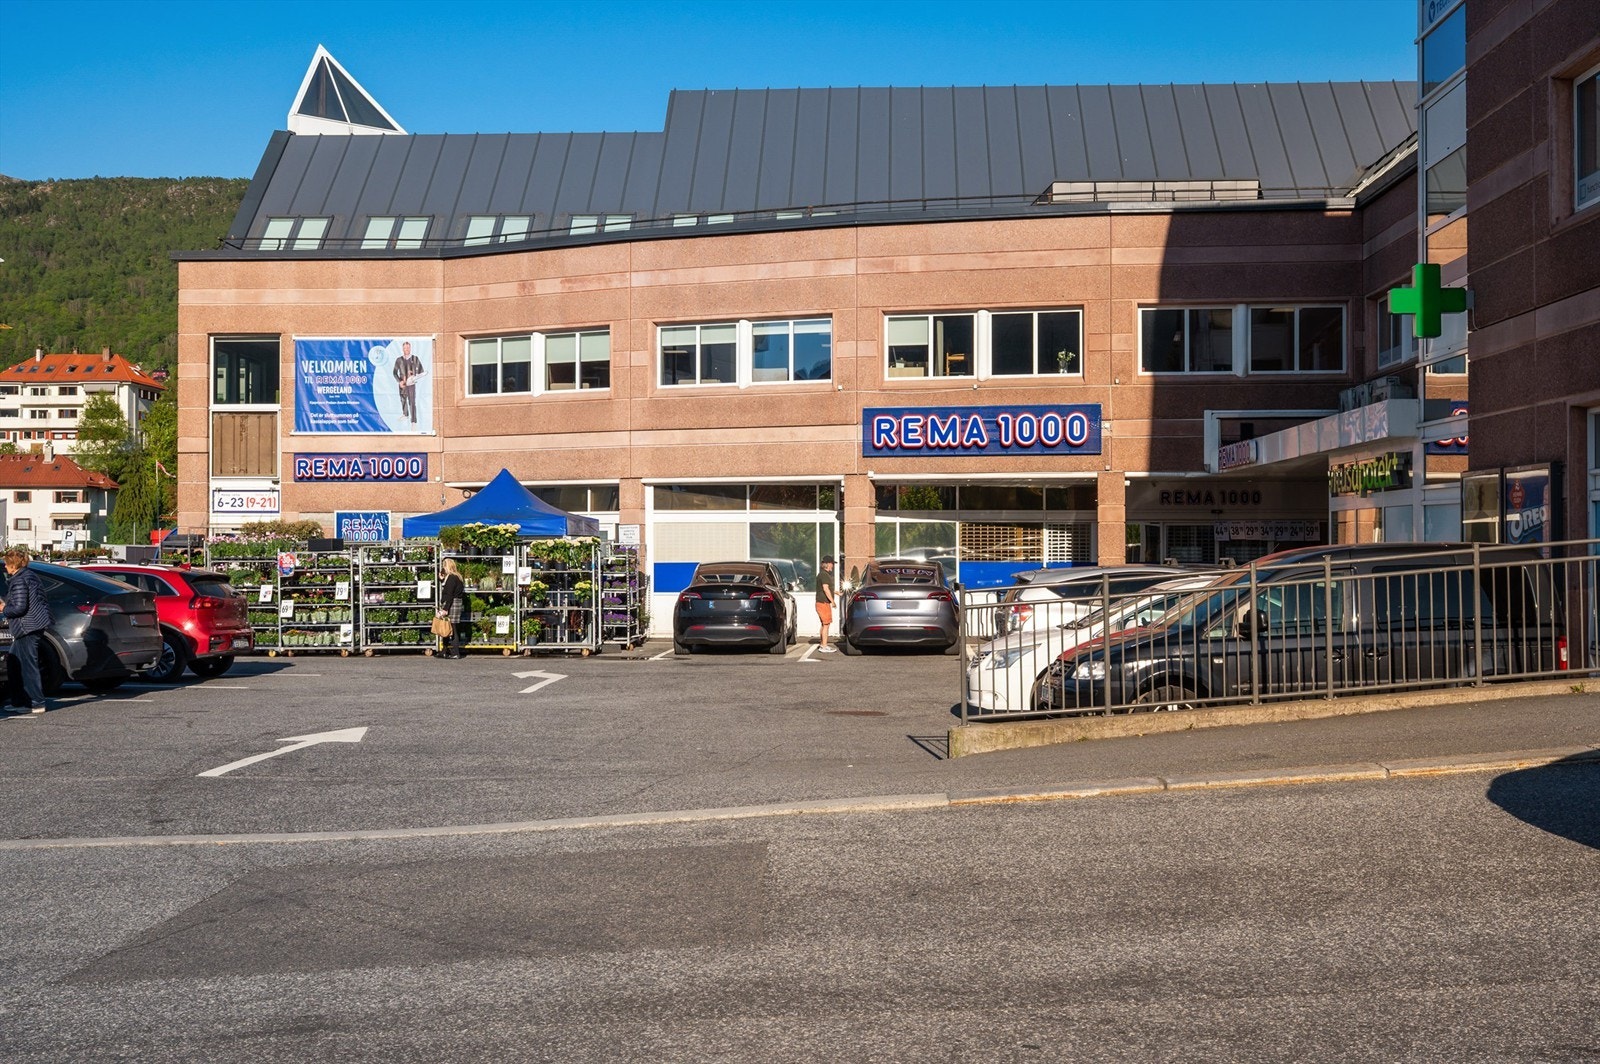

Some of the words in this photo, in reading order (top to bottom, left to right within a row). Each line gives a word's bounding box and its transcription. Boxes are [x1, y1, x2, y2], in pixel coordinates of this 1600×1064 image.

[302, 360, 367, 373] VELKOMMEN
[304, 376, 314, 385] TIL
[315, 375, 345, 385] REMA
[346, 375, 367, 385] 1000
[316, 386, 353, 395] WERGELAND
[872, 413, 989, 448] REMA
[996, 411, 1089, 447] 1000
[295, 458, 364, 479] REMA
[370, 457, 423, 477] 1000
[217, 497, 244, 508] 6-23
[246, 496, 277, 509] (9-21)
[1159, 490, 1215, 505] REMA
[1219, 490, 1262, 505] 1000
[342, 518, 383, 530] REMA
[1510, 506, 1547, 538] OREO
[65, 530, 73, 540] P
[346, 530, 378, 541] 1000
